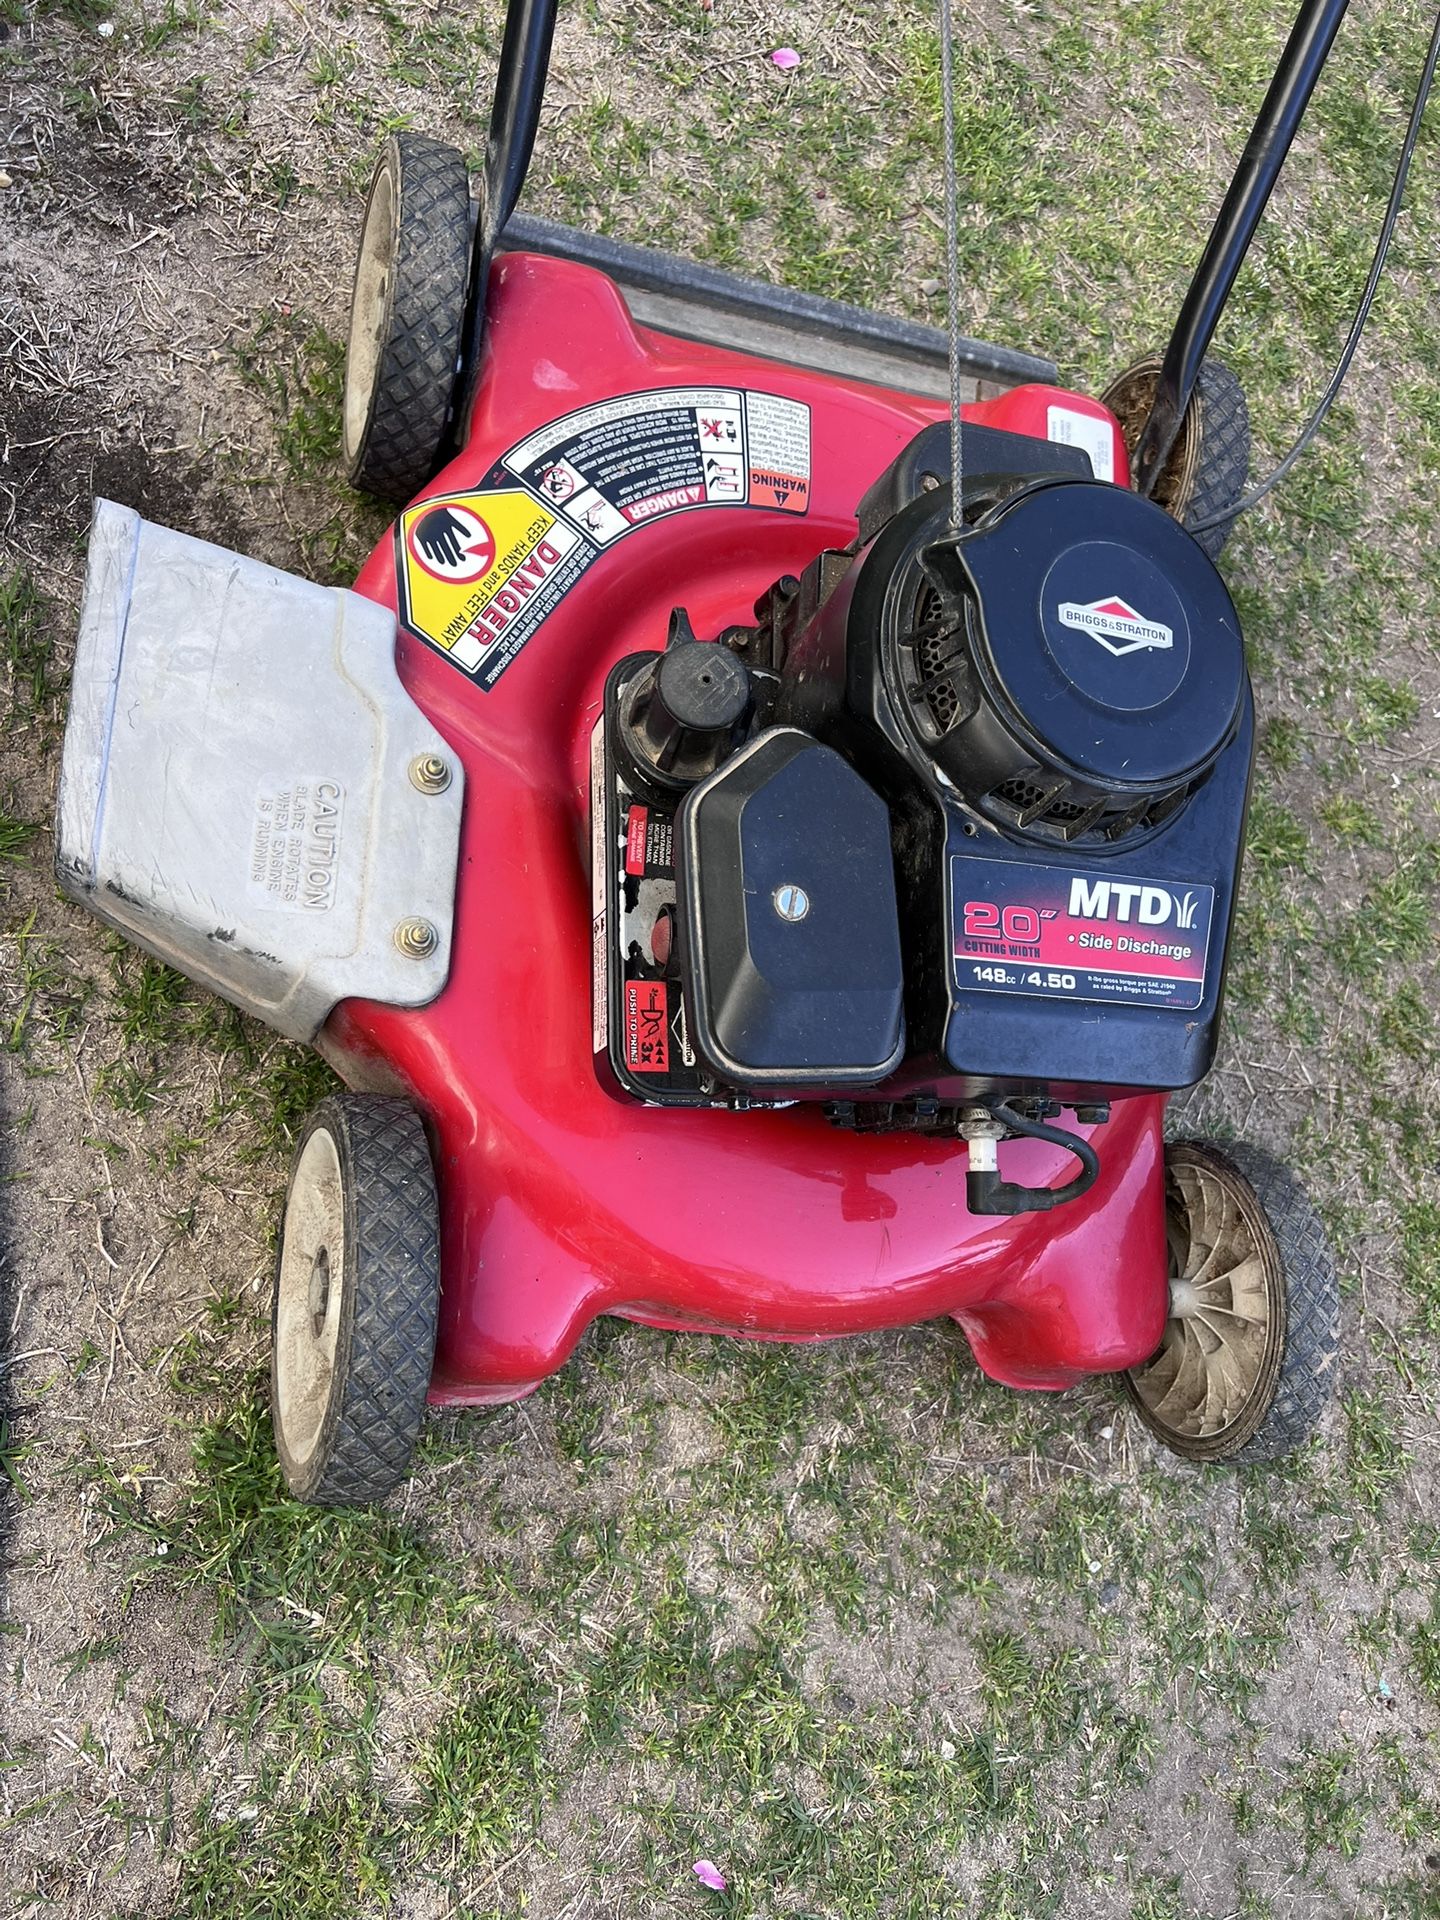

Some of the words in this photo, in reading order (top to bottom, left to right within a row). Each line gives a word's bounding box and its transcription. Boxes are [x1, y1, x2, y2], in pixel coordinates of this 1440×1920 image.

[752, 474, 806, 493] WARNING
[628, 491, 688, 519] DANGER
[522, 514, 549, 544] KEEP
[496, 539, 529, 576] HANDS
[565, 557, 576, 569] OR
[571, 541, 590, 561] COVER
[577, 554, 591, 569] NOT
[586, 547, 596, 558] DO
[482, 570, 503, 593] and
[552, 565, 570, 585] ENTIRE
[558, 566, 581, 593] OPERATE
[462, 588, 489, 617] FEET
[466, 539, 562, 649] DANGER
[539, 581, 557, 601] GRASS
[541, 589, 562, 613] UNLESS
[521, 597, 544, 624] CATCHER
[533, 609, 546, 622] AN
[438, 611, 469, 644] AWAY
[508, 619, 538, 654] UNDAMAGED
[510, 626, 521, 637] IN
[516, 620, 526, 629] IS
[483, 651, 512, 684] DISCHARGE
[259, 799, 273, 812] IS
[273, 792, 291, 832] WHEN
[290, 786, 307, 830] BLADE
[638, 821, 644, 830] TO
[667, 826, 672, 834] OR
[253, 820, 272, 882] RUNNING
[304, 783, 340, 910] CAUTION
[636, 831, 644, 863] PREVENT
[268, 839, 286, 892] ENGINE
[283, 838, 303, 901] ROTATES
[1068, 878, 1172, 924] MTD
[964, 940, 1006, 955] CUTTING
[1008, 944, 1041, 958] WIDTH
[1078, 932, 1113, 950] Side
[1118, 936, 1192, 960] Discharge
[1027, 972, 1076, 990] 4.50
[1124, 985, 1141, 994] Briggs
[629, 989, 637, 1014] PUSH
[630, 1018, 637, 1030] TO
[630, 1034, 638, 1063] PRIME
